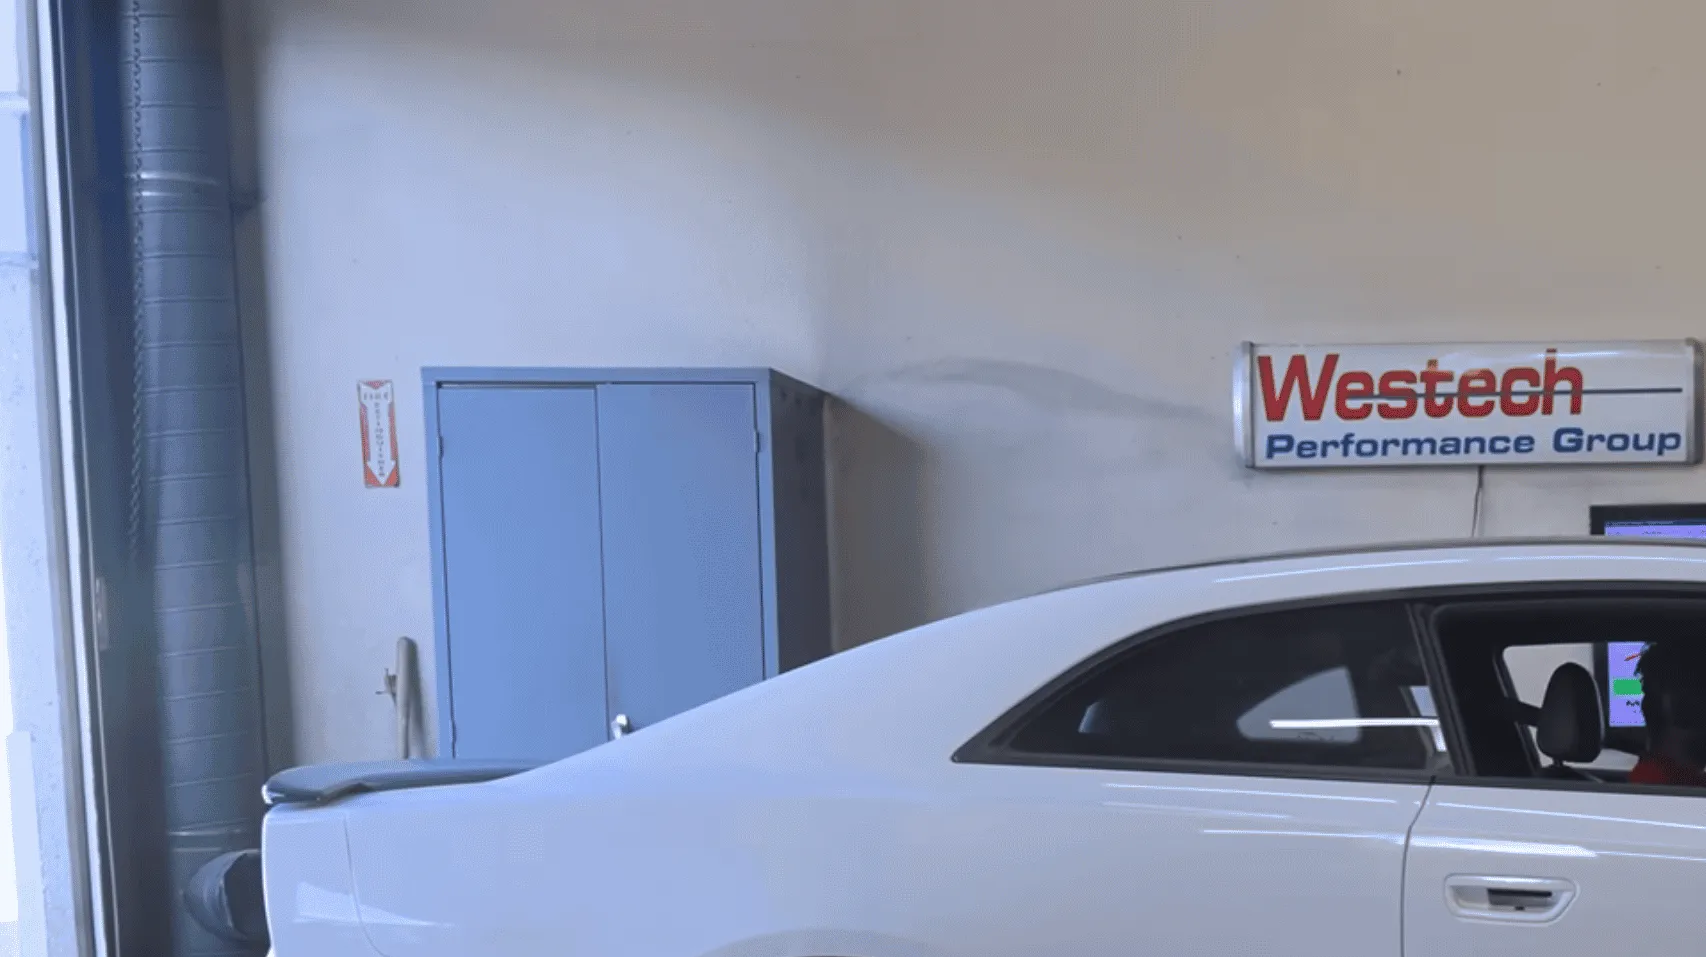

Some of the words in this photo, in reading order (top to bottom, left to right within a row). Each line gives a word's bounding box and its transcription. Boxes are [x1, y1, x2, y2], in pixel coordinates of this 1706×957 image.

[1257, 348, 1583, 421] Westech
[1265, 432, 1535, 459] Performance
[1552, 427, 1682, 456] Group
